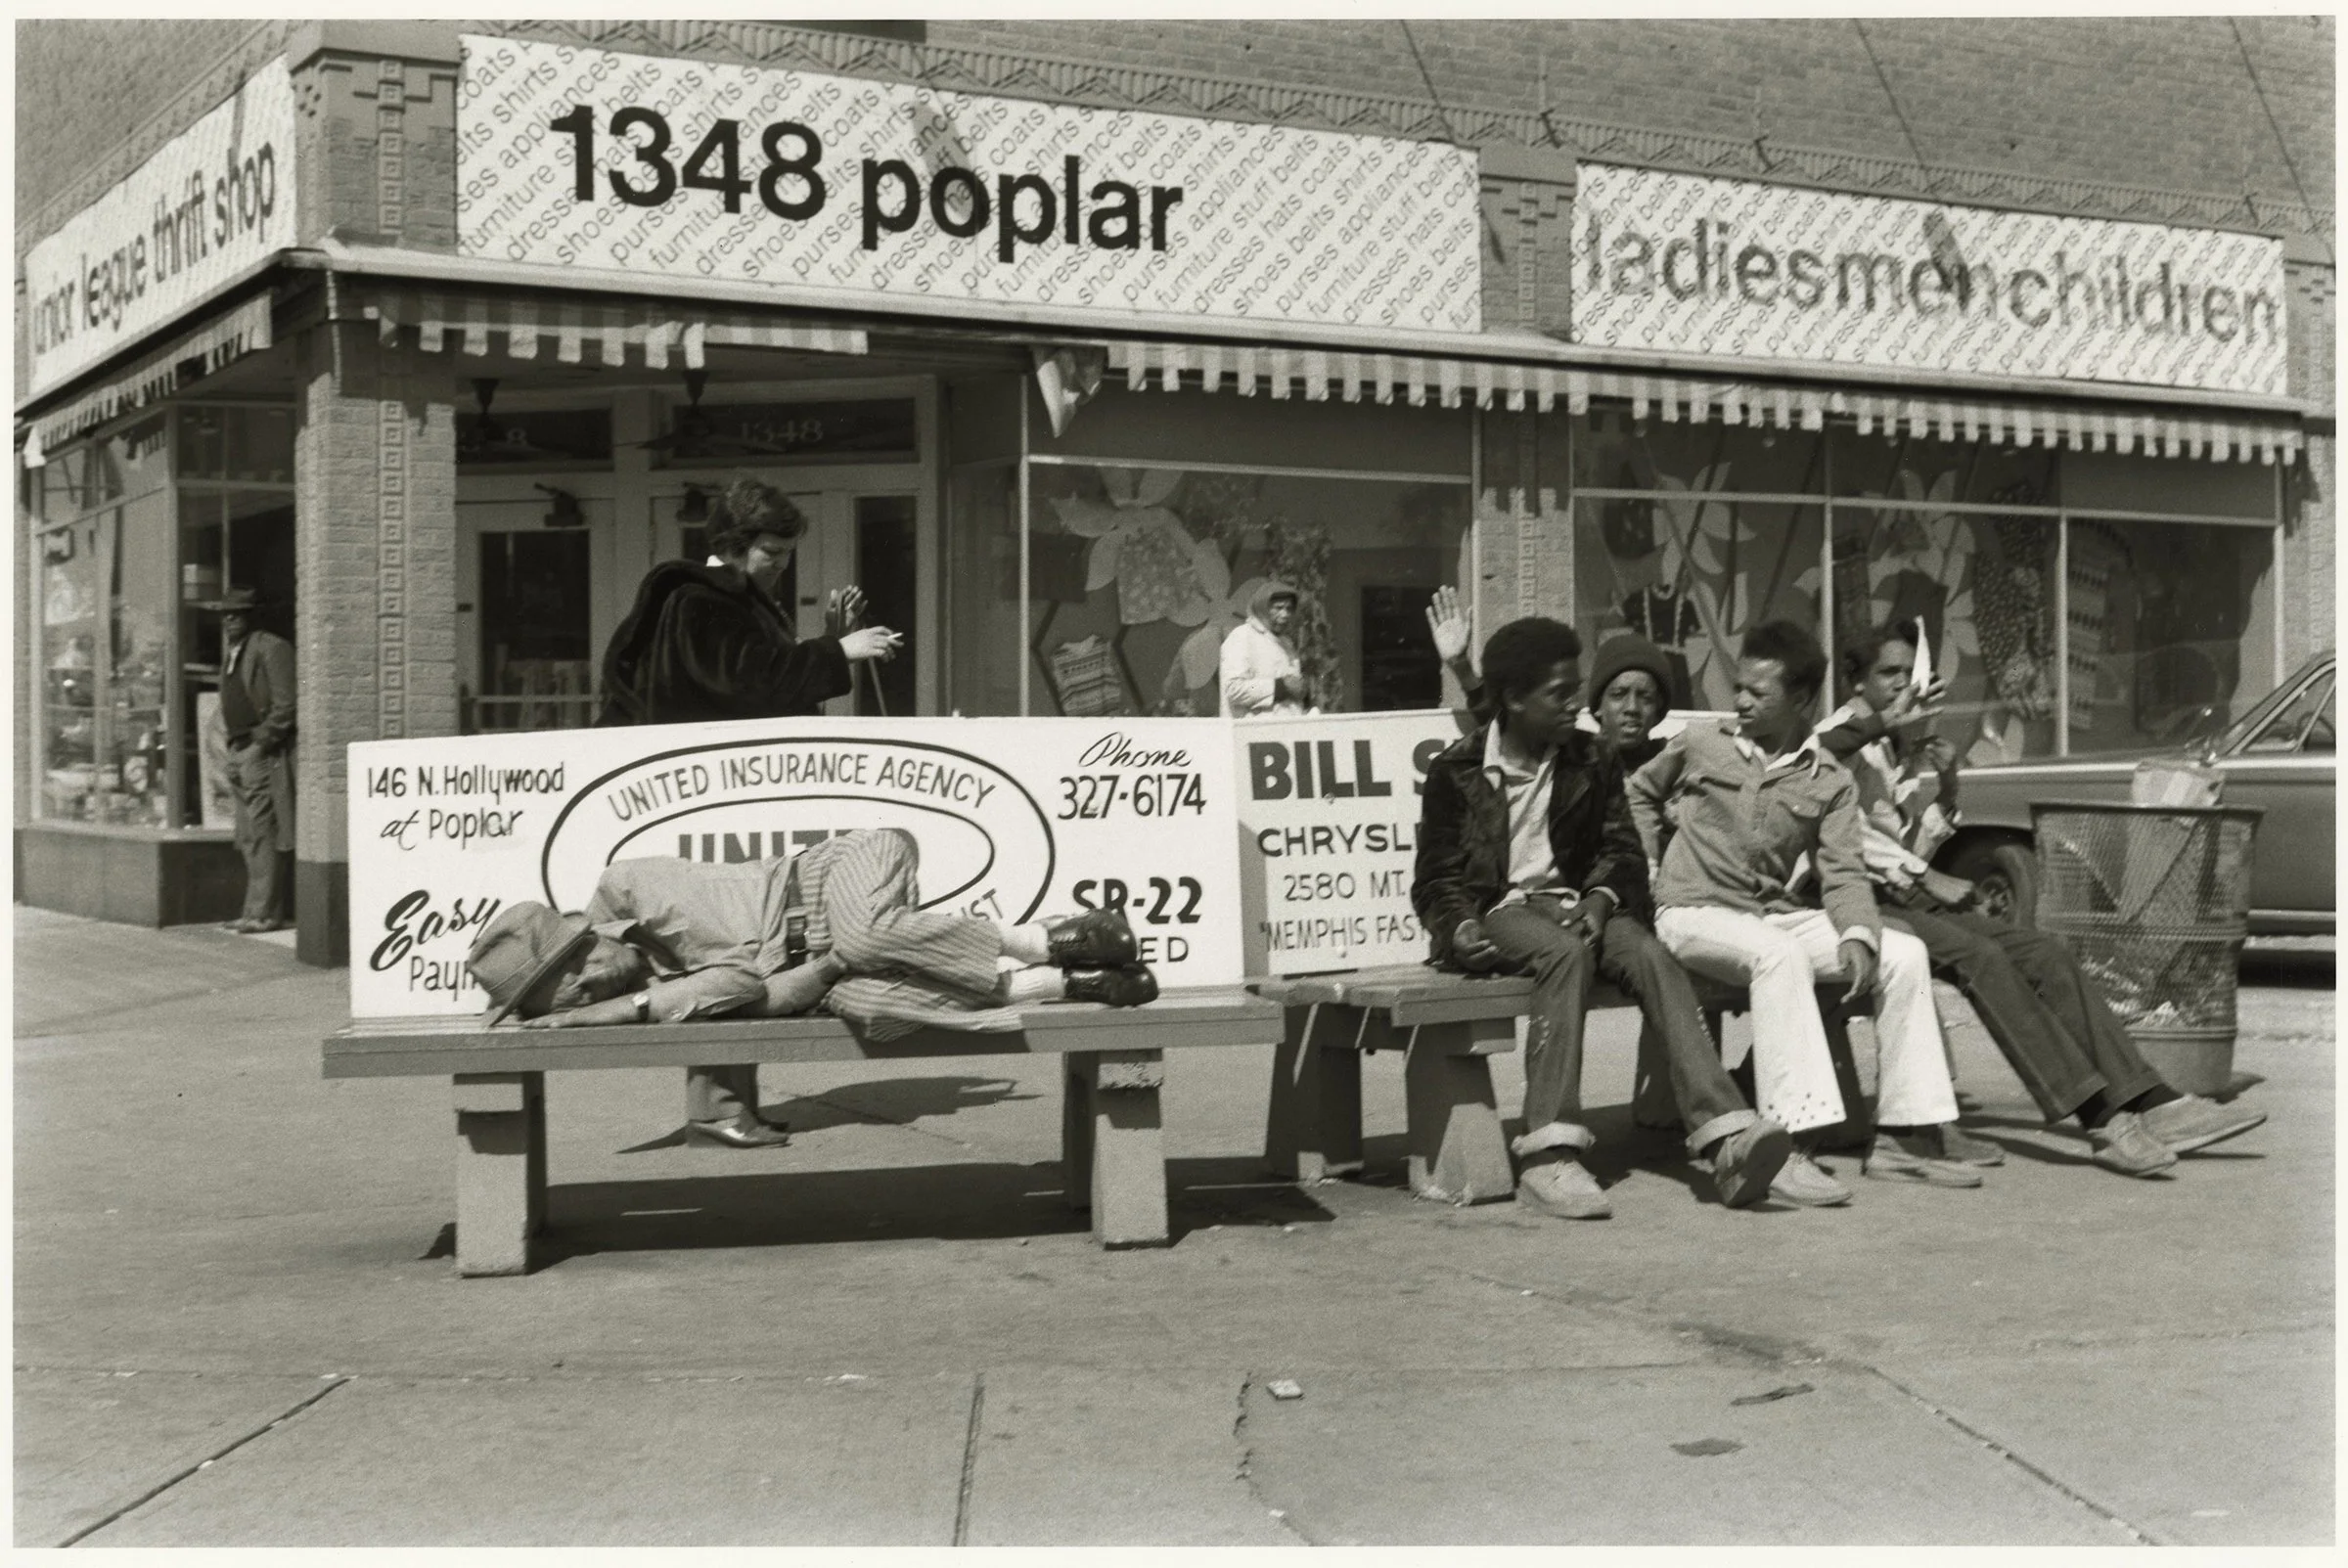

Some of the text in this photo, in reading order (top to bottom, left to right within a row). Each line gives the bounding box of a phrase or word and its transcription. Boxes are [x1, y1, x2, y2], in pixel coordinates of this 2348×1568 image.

[494, 63, 556, 124] shirts
[685, 84, 742, 141] shirts
[951, 103, 1009, 152] belts
[1109, 117, 1168, 169] belts
[1147, 124, 1200, 180] coats
[1182, 135, 1234, 189] shirts
[1187, 127, 1284, 230] appliances
[550, 104, 826, 222] 1348
[862, 155, 1184, 264] poplar
[695, 202, 767, 274] dresse
[821, 89, 879, 146] coats
[867, 222, 938, 293] dresse
[988, 109, 1045, 165] coats
[81, 229, 147, 333] league
[154, 169, 207, 282] thrift
[214, 140, 275, 248] shop
[509, 187, 582, 260] dresse
[1152, 228, 1234, 308] furniture
[1231, 176, 1276, 227] stuff
[1265, 135, 1318, 182] belts
[1194, 139, 1351, 311] dresses hats coats
[1235, 152, 1382, 313] shoes belts shirts
[1273, 144, 1428, 317] purses appliances
[1304, 241, 1383, 319] furniture
[1378, 193, 1422, 242] stuff
[1342, 250, 1411, 323] dresses
[1401, 209, 1446, 252] hats
[1379, 219, 1475, 324] shoes belts
[1418, 256, 1479, 327] purses
[367, 766, 408, 798] 146
[1078, 731, 1192, 768] Phone
[1247, 739, 1392, 801] BILL
[608, 752, 997, 823] UNITED INSURANCE AGENCY
[1058, 773, 1207, 821] 327-6174
[380, 808, 524, 851] at Poplar
[1072, 875, 1203, 925] SR-22
[1283, 869, 1406, 902] 2580 MT.
[369, 889, 501, 972] Easy
[1376, 914, 1424, 944] FAS
